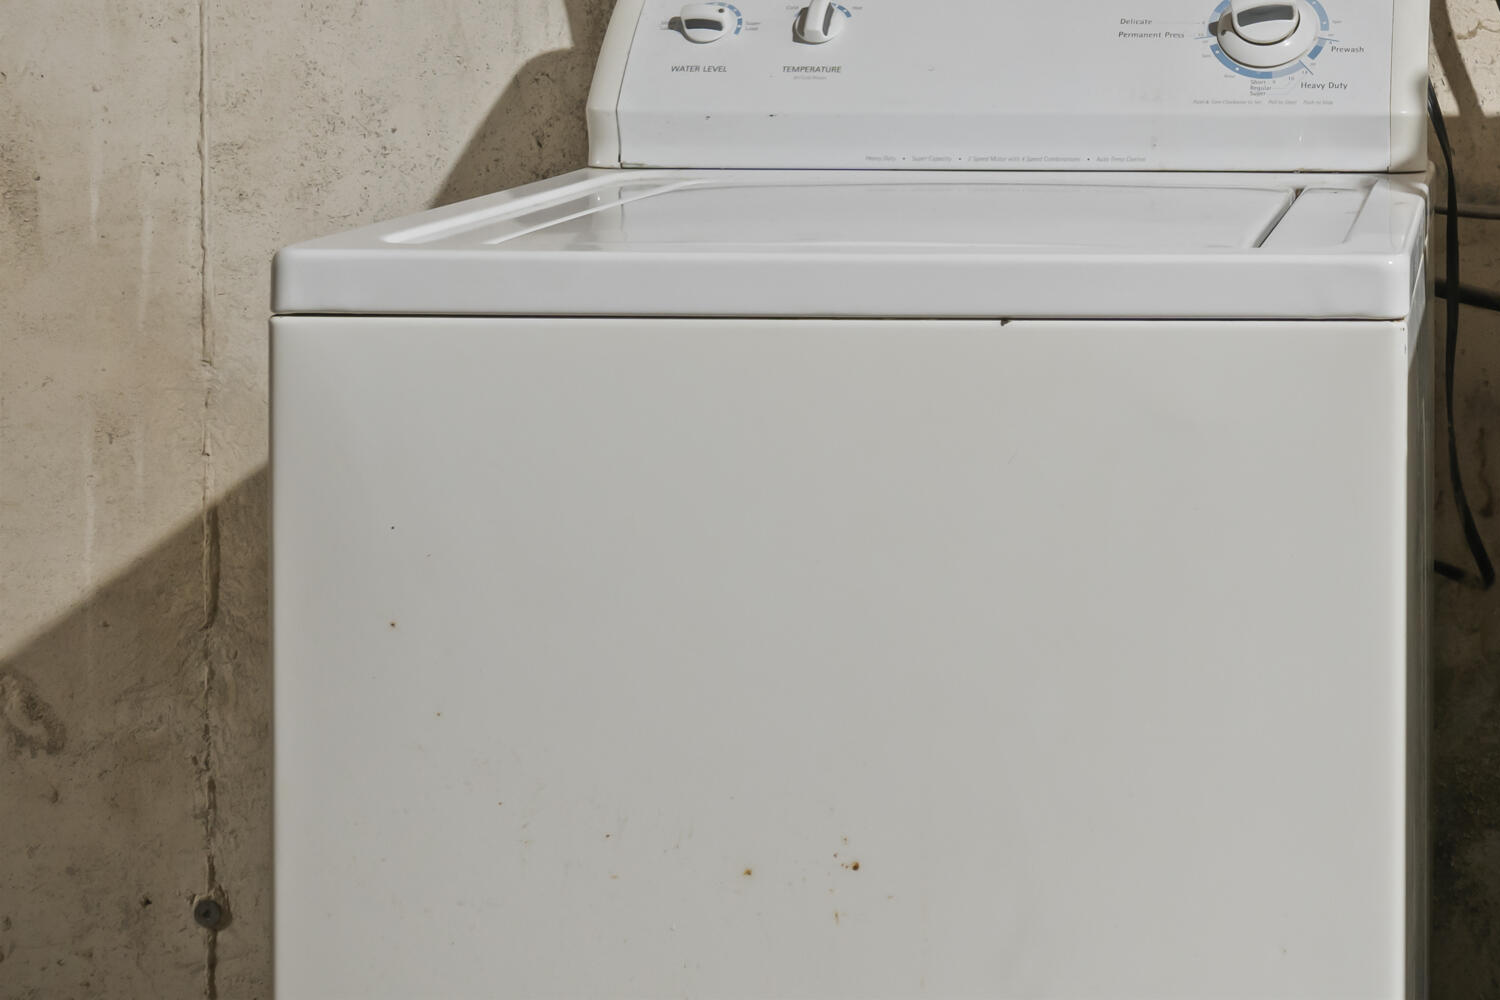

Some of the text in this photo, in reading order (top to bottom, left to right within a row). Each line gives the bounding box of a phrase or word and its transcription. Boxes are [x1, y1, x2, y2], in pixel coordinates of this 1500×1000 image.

[1118, 31, 1162, 39] Permanent
[1330, 45, 1365, 53] Prewash
[670, 65, 728, 73] WATER LEVEL
[782, 65, 842, 74] TEMPERATURE
[1300, 81, 1348, 90] Heavy Duty
